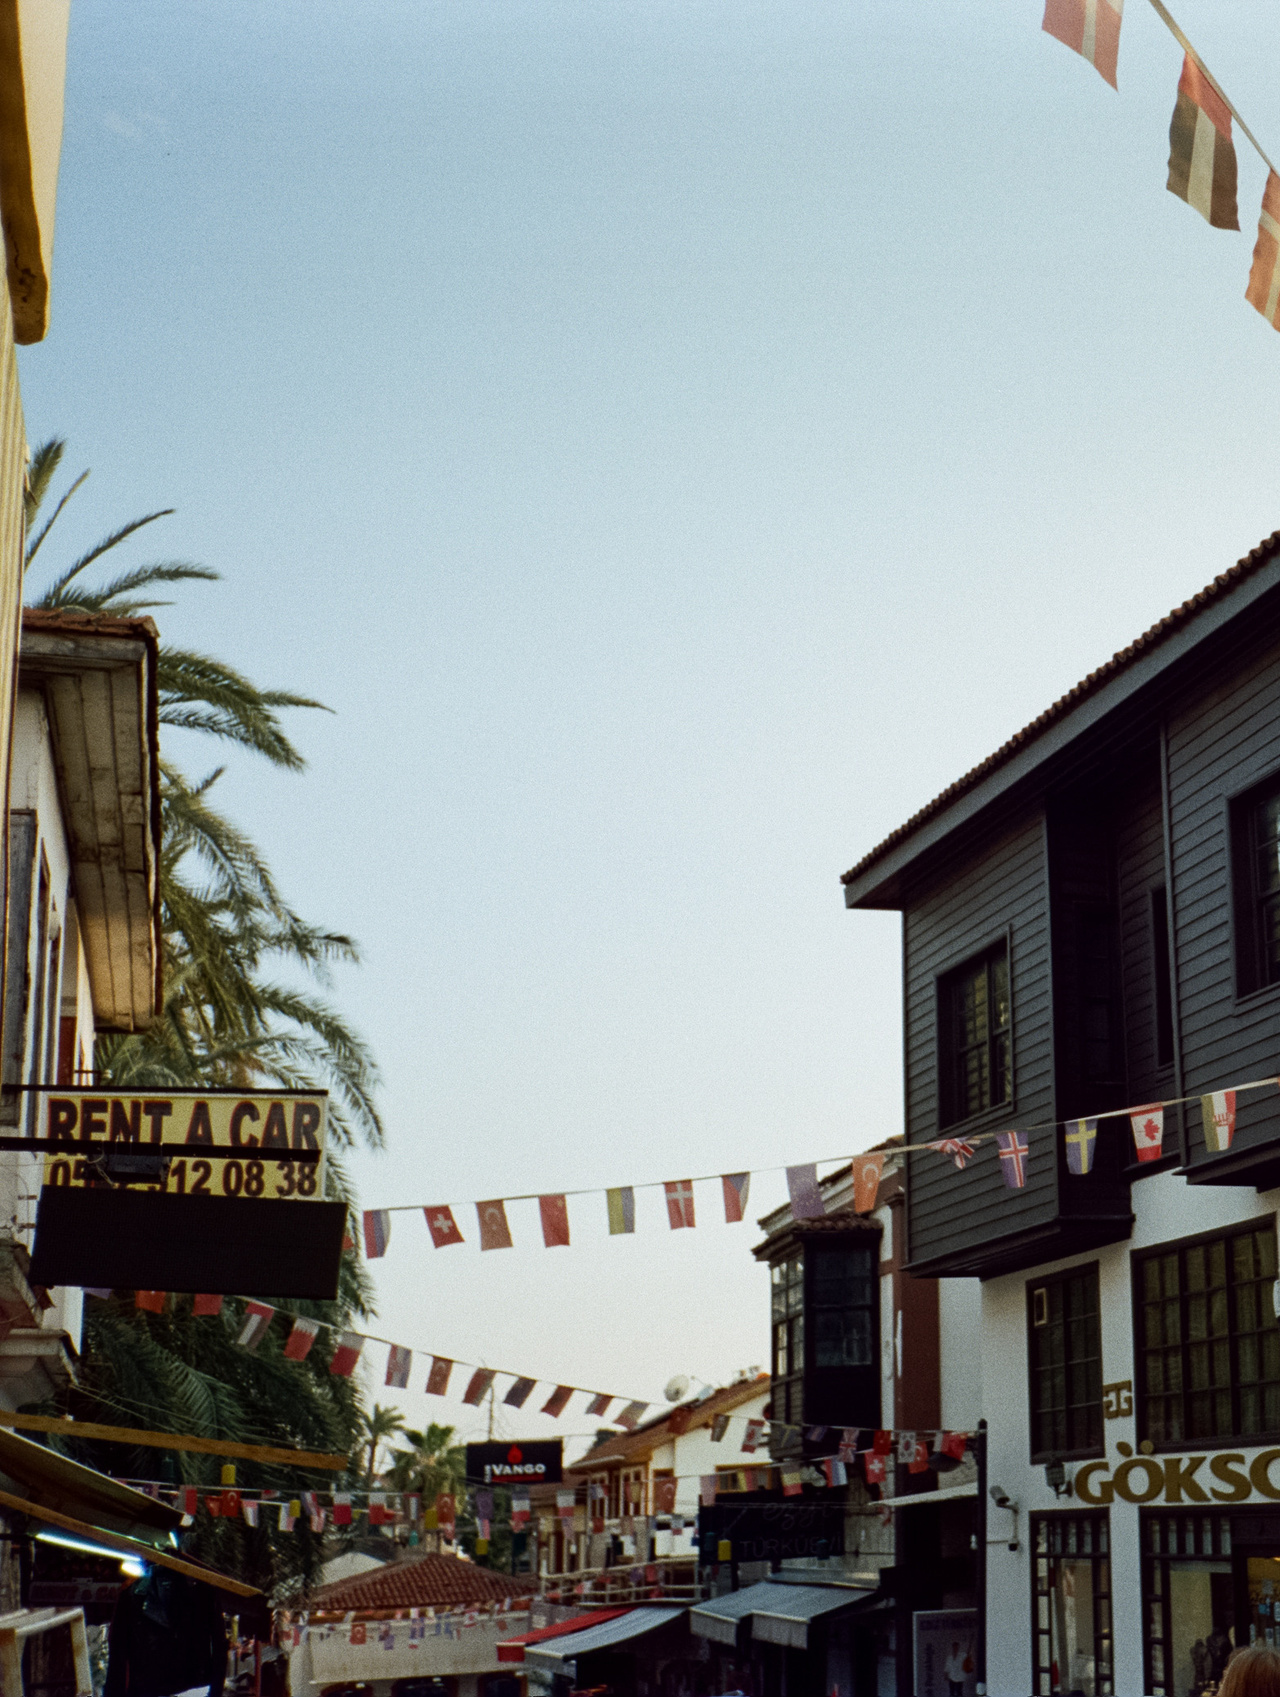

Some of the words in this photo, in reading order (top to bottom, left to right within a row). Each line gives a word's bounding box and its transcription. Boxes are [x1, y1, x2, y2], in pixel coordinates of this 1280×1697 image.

[49, 1099, 172, 1143] RENT
[186, 1101, 214, 1146] A
[230, 1101, 321, 1150] CAR
[223, 1160, 264, 1196] 08
[277, 1160, 317, 1197] 38
[491, 1463, 547, 1475] VANGO
